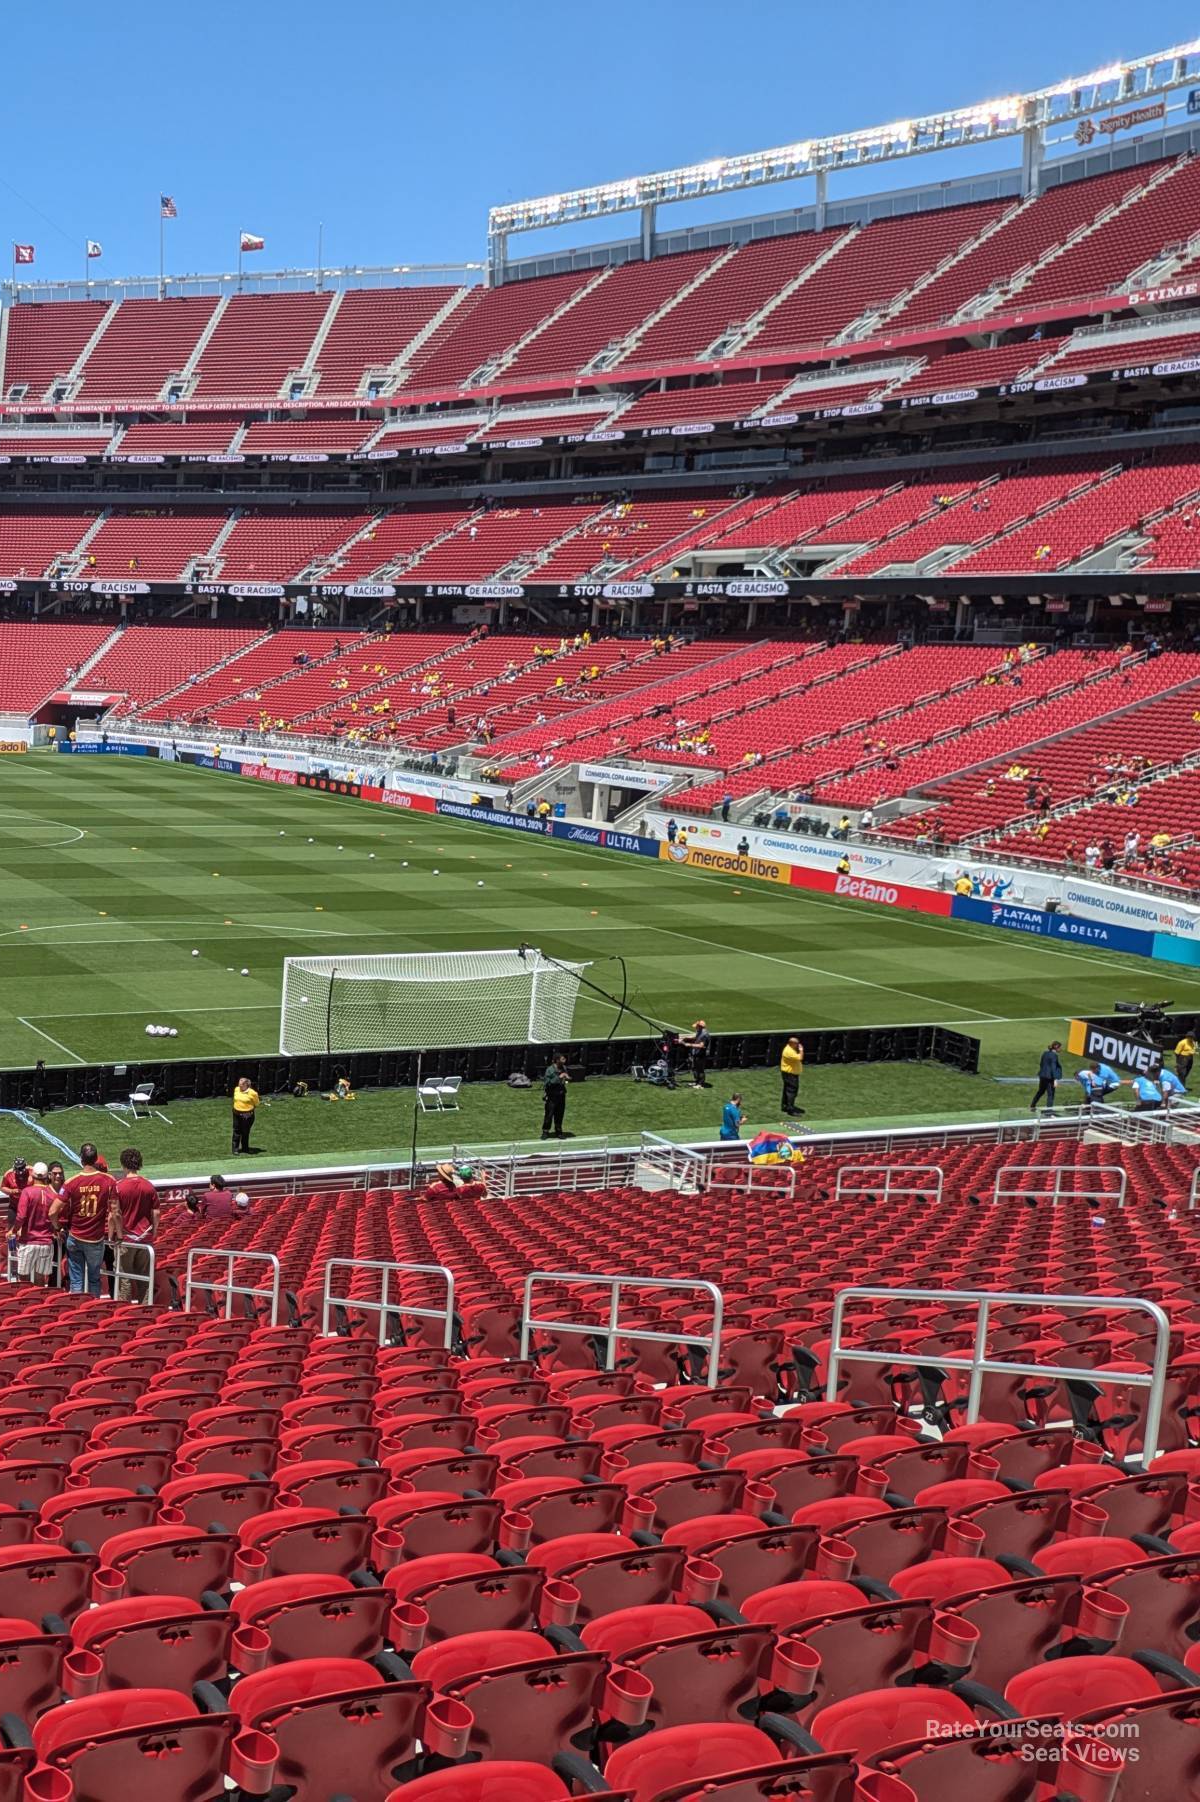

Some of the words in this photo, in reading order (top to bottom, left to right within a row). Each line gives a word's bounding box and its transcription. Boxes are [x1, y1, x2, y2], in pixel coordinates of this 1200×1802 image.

[1131, 107, 1162, 123] Health
[1128, 284, 1198, 305] 5-TIME
[1124, 368, 1150, 378] BASTA
[1010, 383, 1033, 392] STOP
[1044, 378, 1076, 388] RACISM
[823, 410, 841, 418] STOP
[63, 582, 88, 591] STOP
[101, 583, 137, 592] RACISM
[198, 586, 225, 594] BASTA
[234, 586, 245, 594] DE
[322, 586, 343, 595] STOP
[353, 586, 384, 595] RACISM
[438, 586, 462, 595] BASTA
[470, 587, 480, 595] DE
[482, 586, 520, 595] RACISMO
[574, 586, 601, 596] STOP
[611, 586, 643, 595] RACISM
[697, 584, 723, 594] BASTA
[731, 584, 742, 593] DE
[744, 583, 784, 593] RACISMO
[585, 770, 612, 780] CONMEBOL
[625, 775, 646, 784] AMERICA
[381, 790, 411, 808] Betano
[441, 804, 472, 817] CONMEBOL
[472, 810, 486, 820] COPA
[486, 812, 514, 826] AMERICA
[515, 818, 526, 828] USA
[527, 820, 543, 831] 2024
[607, 834, 640, 850] ULTRA
[763, 838, 799, 852] CONMEBOL
[800, 844, 818, 856] COPA
[864, 855, 882, 865] 2024
[692, 850, 747, 875] mercado
[750, 859, 780, 878] libre
[835, 874, 898, 904] Betano
[1004, 908, 1042, 924] LATAM
[1067, 892, 1104, 908] CONMEBOL
[1105, 900, 1125, 913] COPA
[1125, 904, 1158, 921] AMERICA
[1159, 914, 1174, 926] USA
[1175, 917, 1194, 930] 2024
[1003, 920, 1041, 932] AIRLINES
[1070, 924, 1108, 940] DELTA
[79, 1194, 98, 1218] 10
